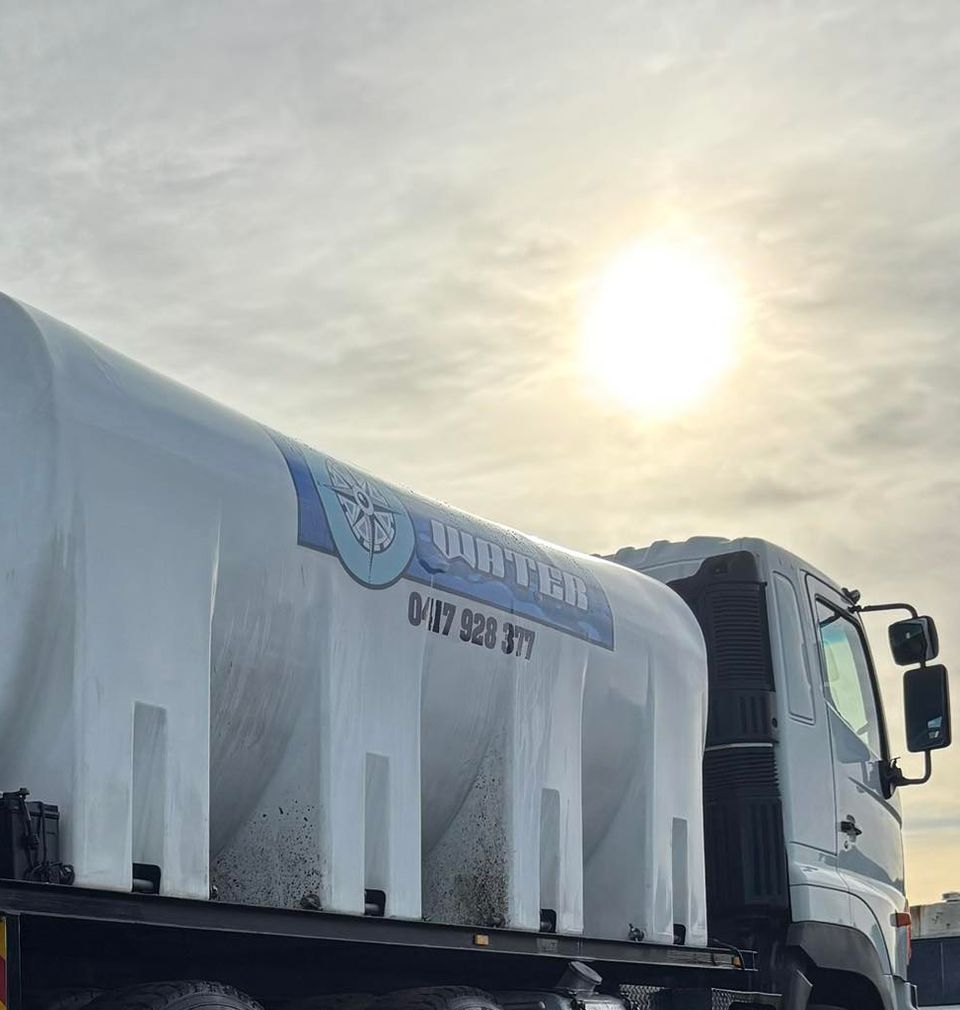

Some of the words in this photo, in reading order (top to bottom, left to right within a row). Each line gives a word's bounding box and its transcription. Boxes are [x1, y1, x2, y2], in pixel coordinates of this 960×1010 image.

[430, 519, 589, 611] WATER
[408, 591, 456, 636] 0417
[460, 608, 498, 650] 928
[501, 622, 536, 661] 377
